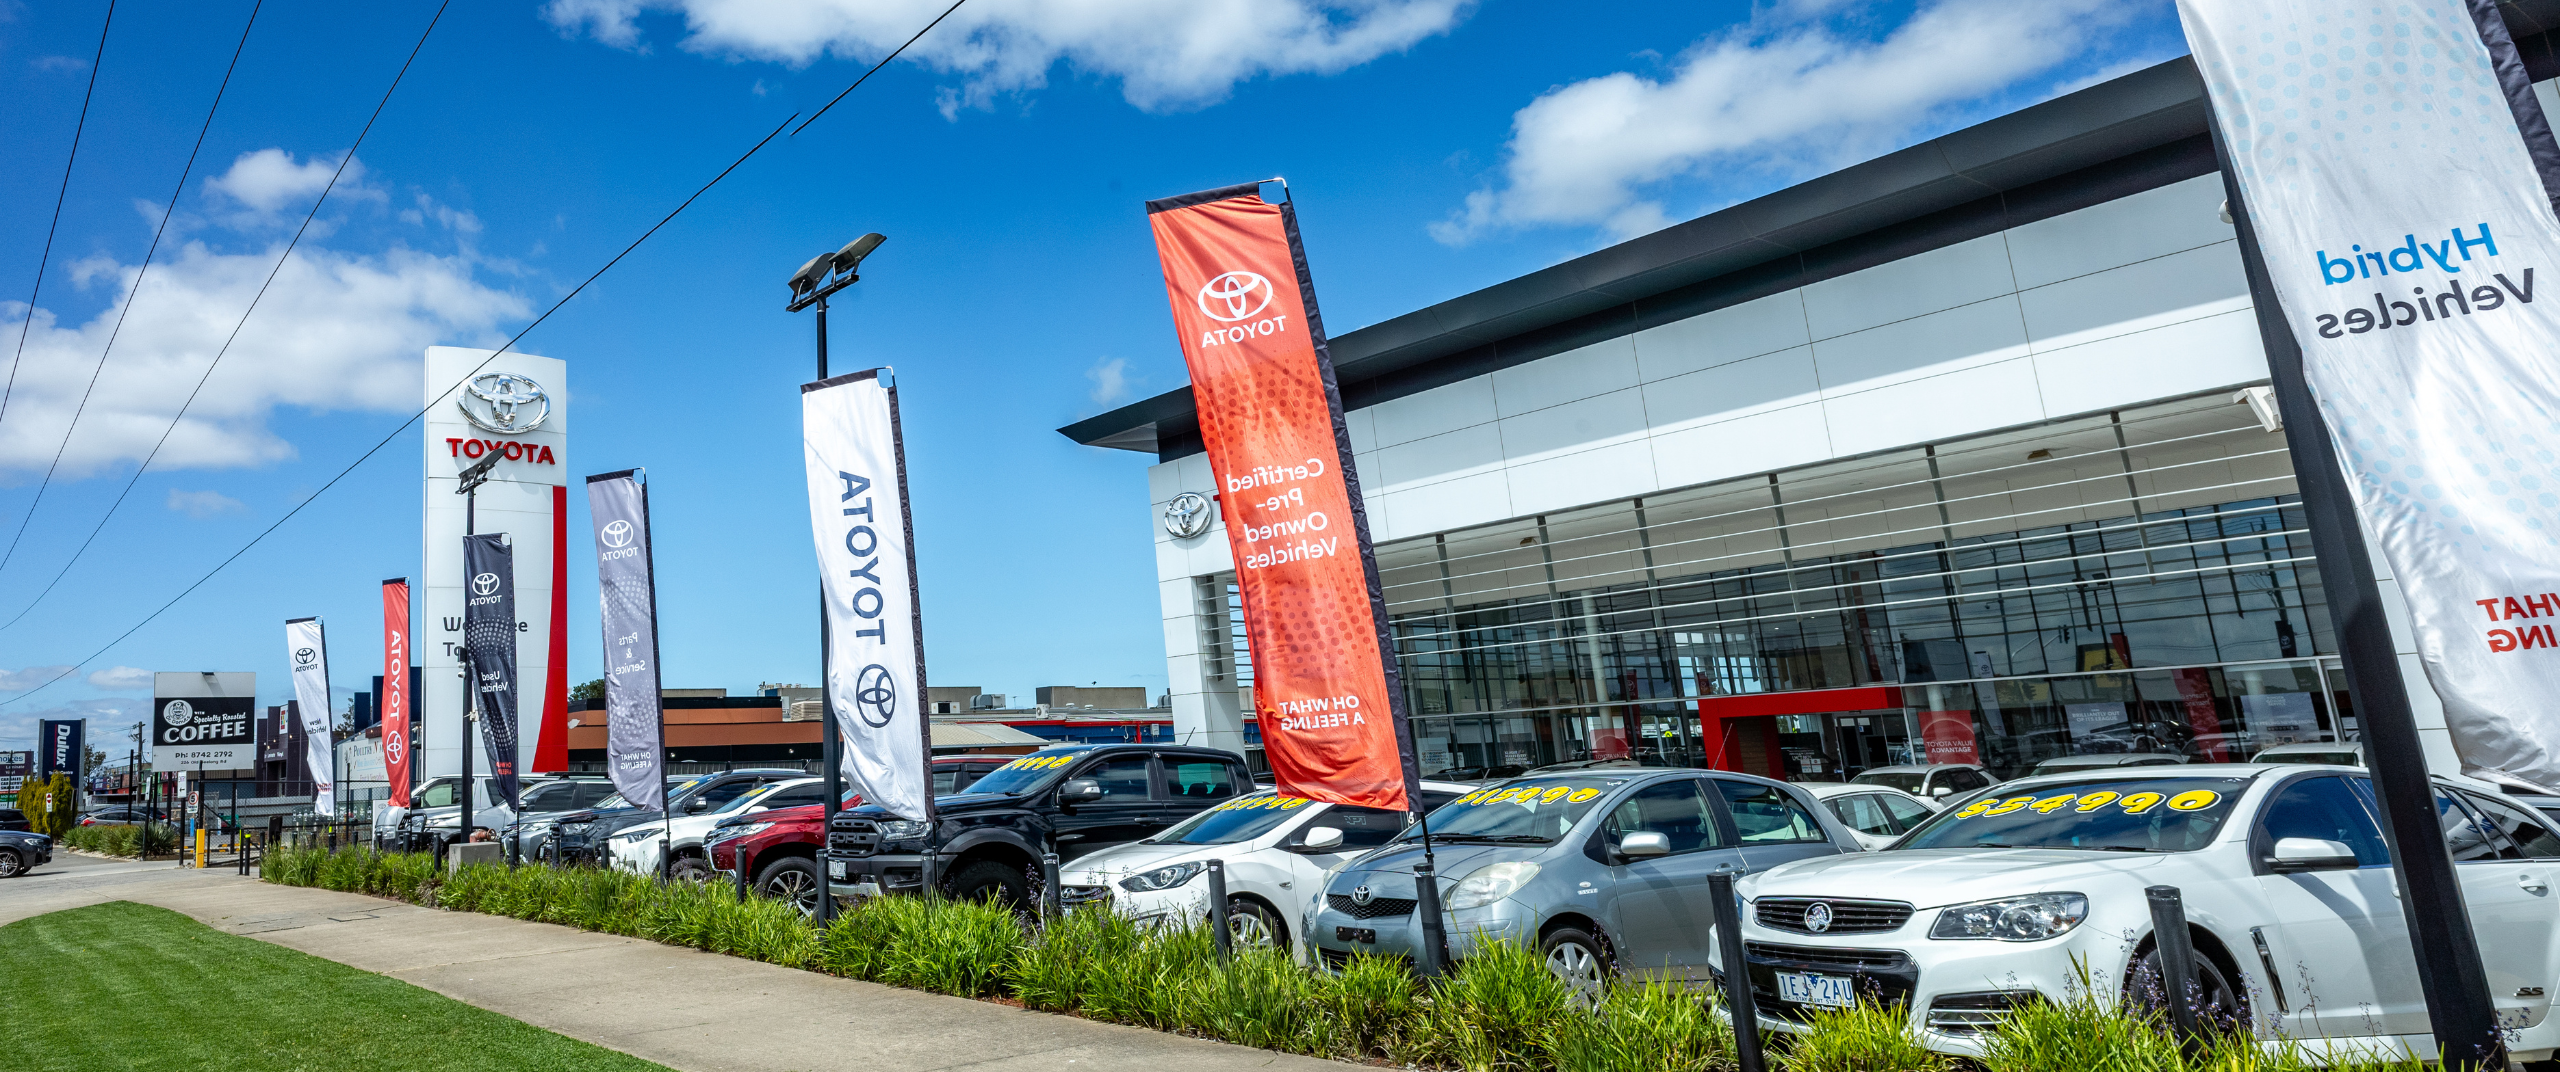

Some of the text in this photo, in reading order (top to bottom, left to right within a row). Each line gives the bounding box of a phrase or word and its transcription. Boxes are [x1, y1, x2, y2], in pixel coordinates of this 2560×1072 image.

[194, 712, 246, 724] Specialty Roasted
[163, 721, 246, 743] COFFEE
[56, 724, 70, 768] Dulux
[190, 794, 195, 802] 5
[1455, 786, 1602, 806] $15990
[1955, 790, 2221, 819] $54990
[1820, 979, 1853, 1001] 2AU
[2514, 986, 2544, 997] SS
